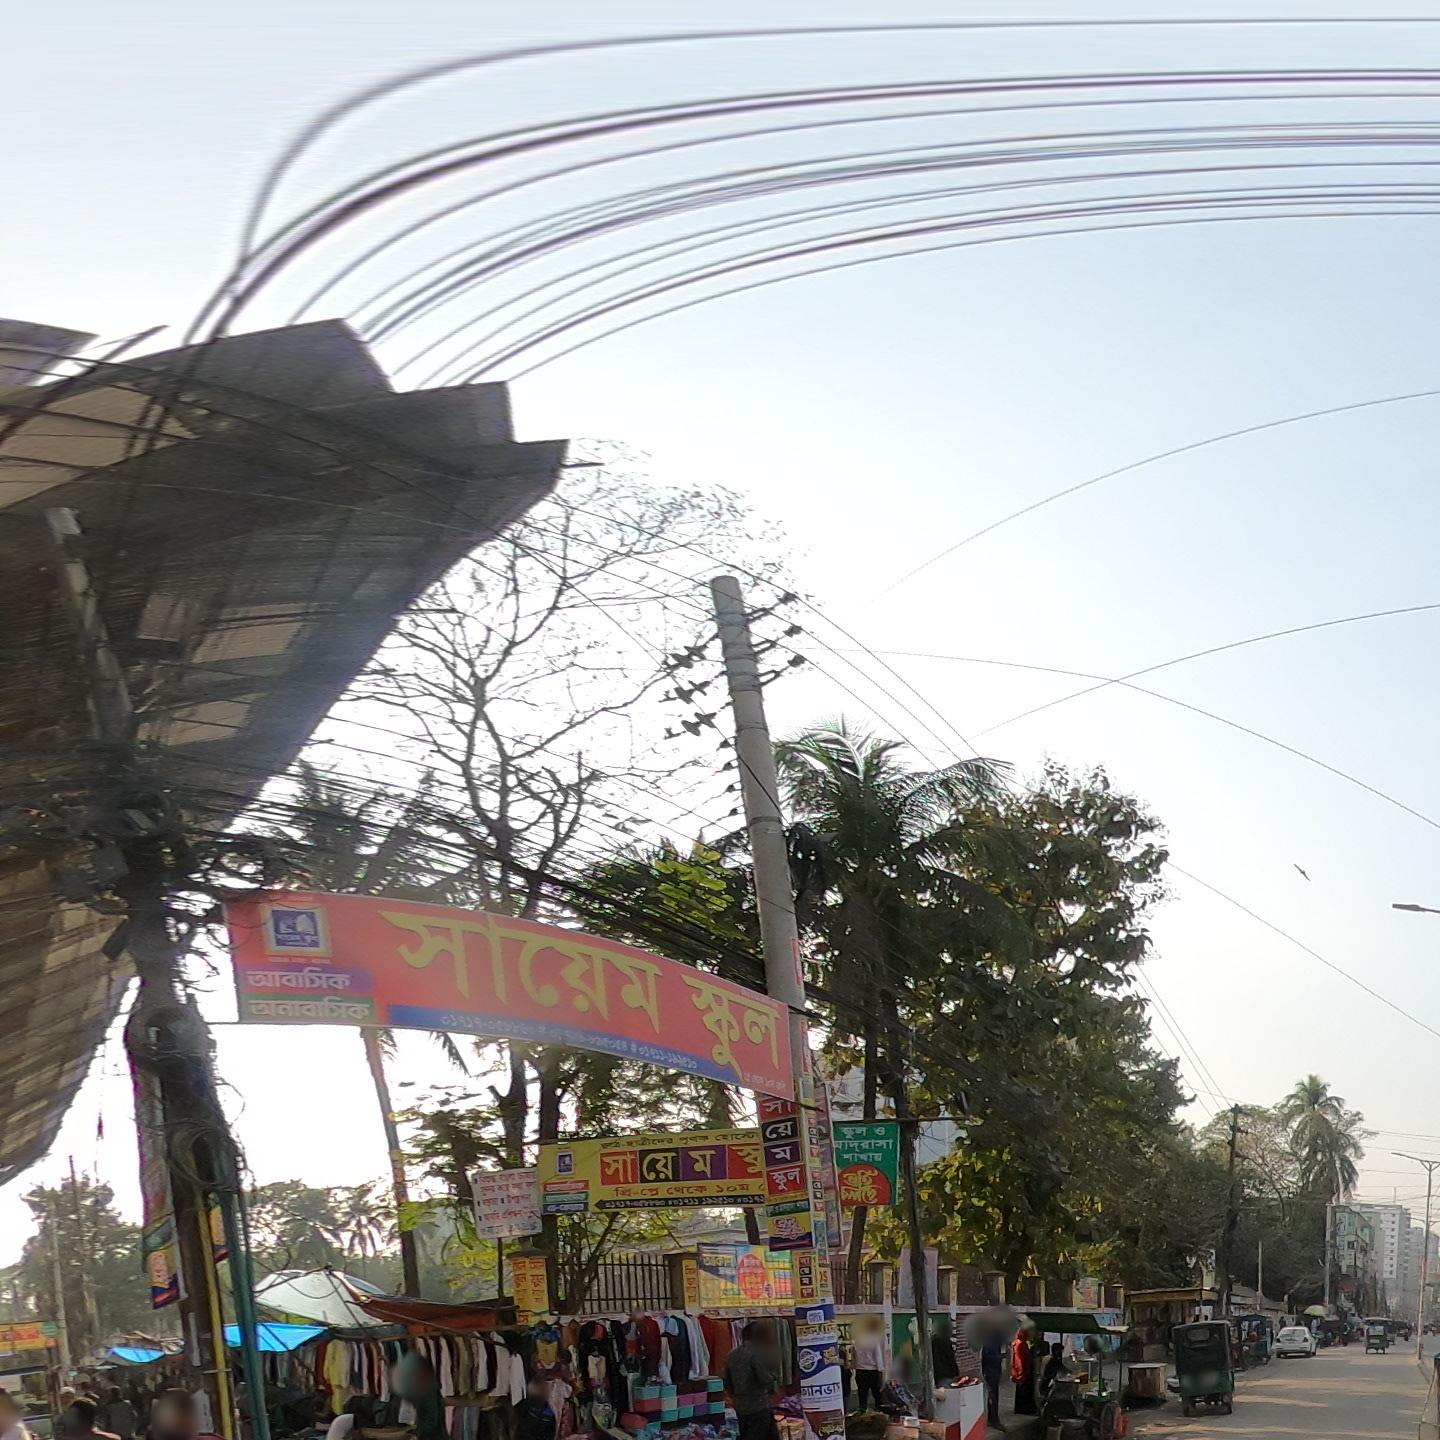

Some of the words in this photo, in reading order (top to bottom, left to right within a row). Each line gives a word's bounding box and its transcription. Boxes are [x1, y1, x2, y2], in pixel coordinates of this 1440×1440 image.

[247, 966, 351, 990] আবাসিক
[377, 909, 663, 1035] সায়েম
[681, 973, 780, 1081] স্কুল
[250, 997, 370, 1019] অনাবাসিক
[874, 1126, 886, 1136] ও
